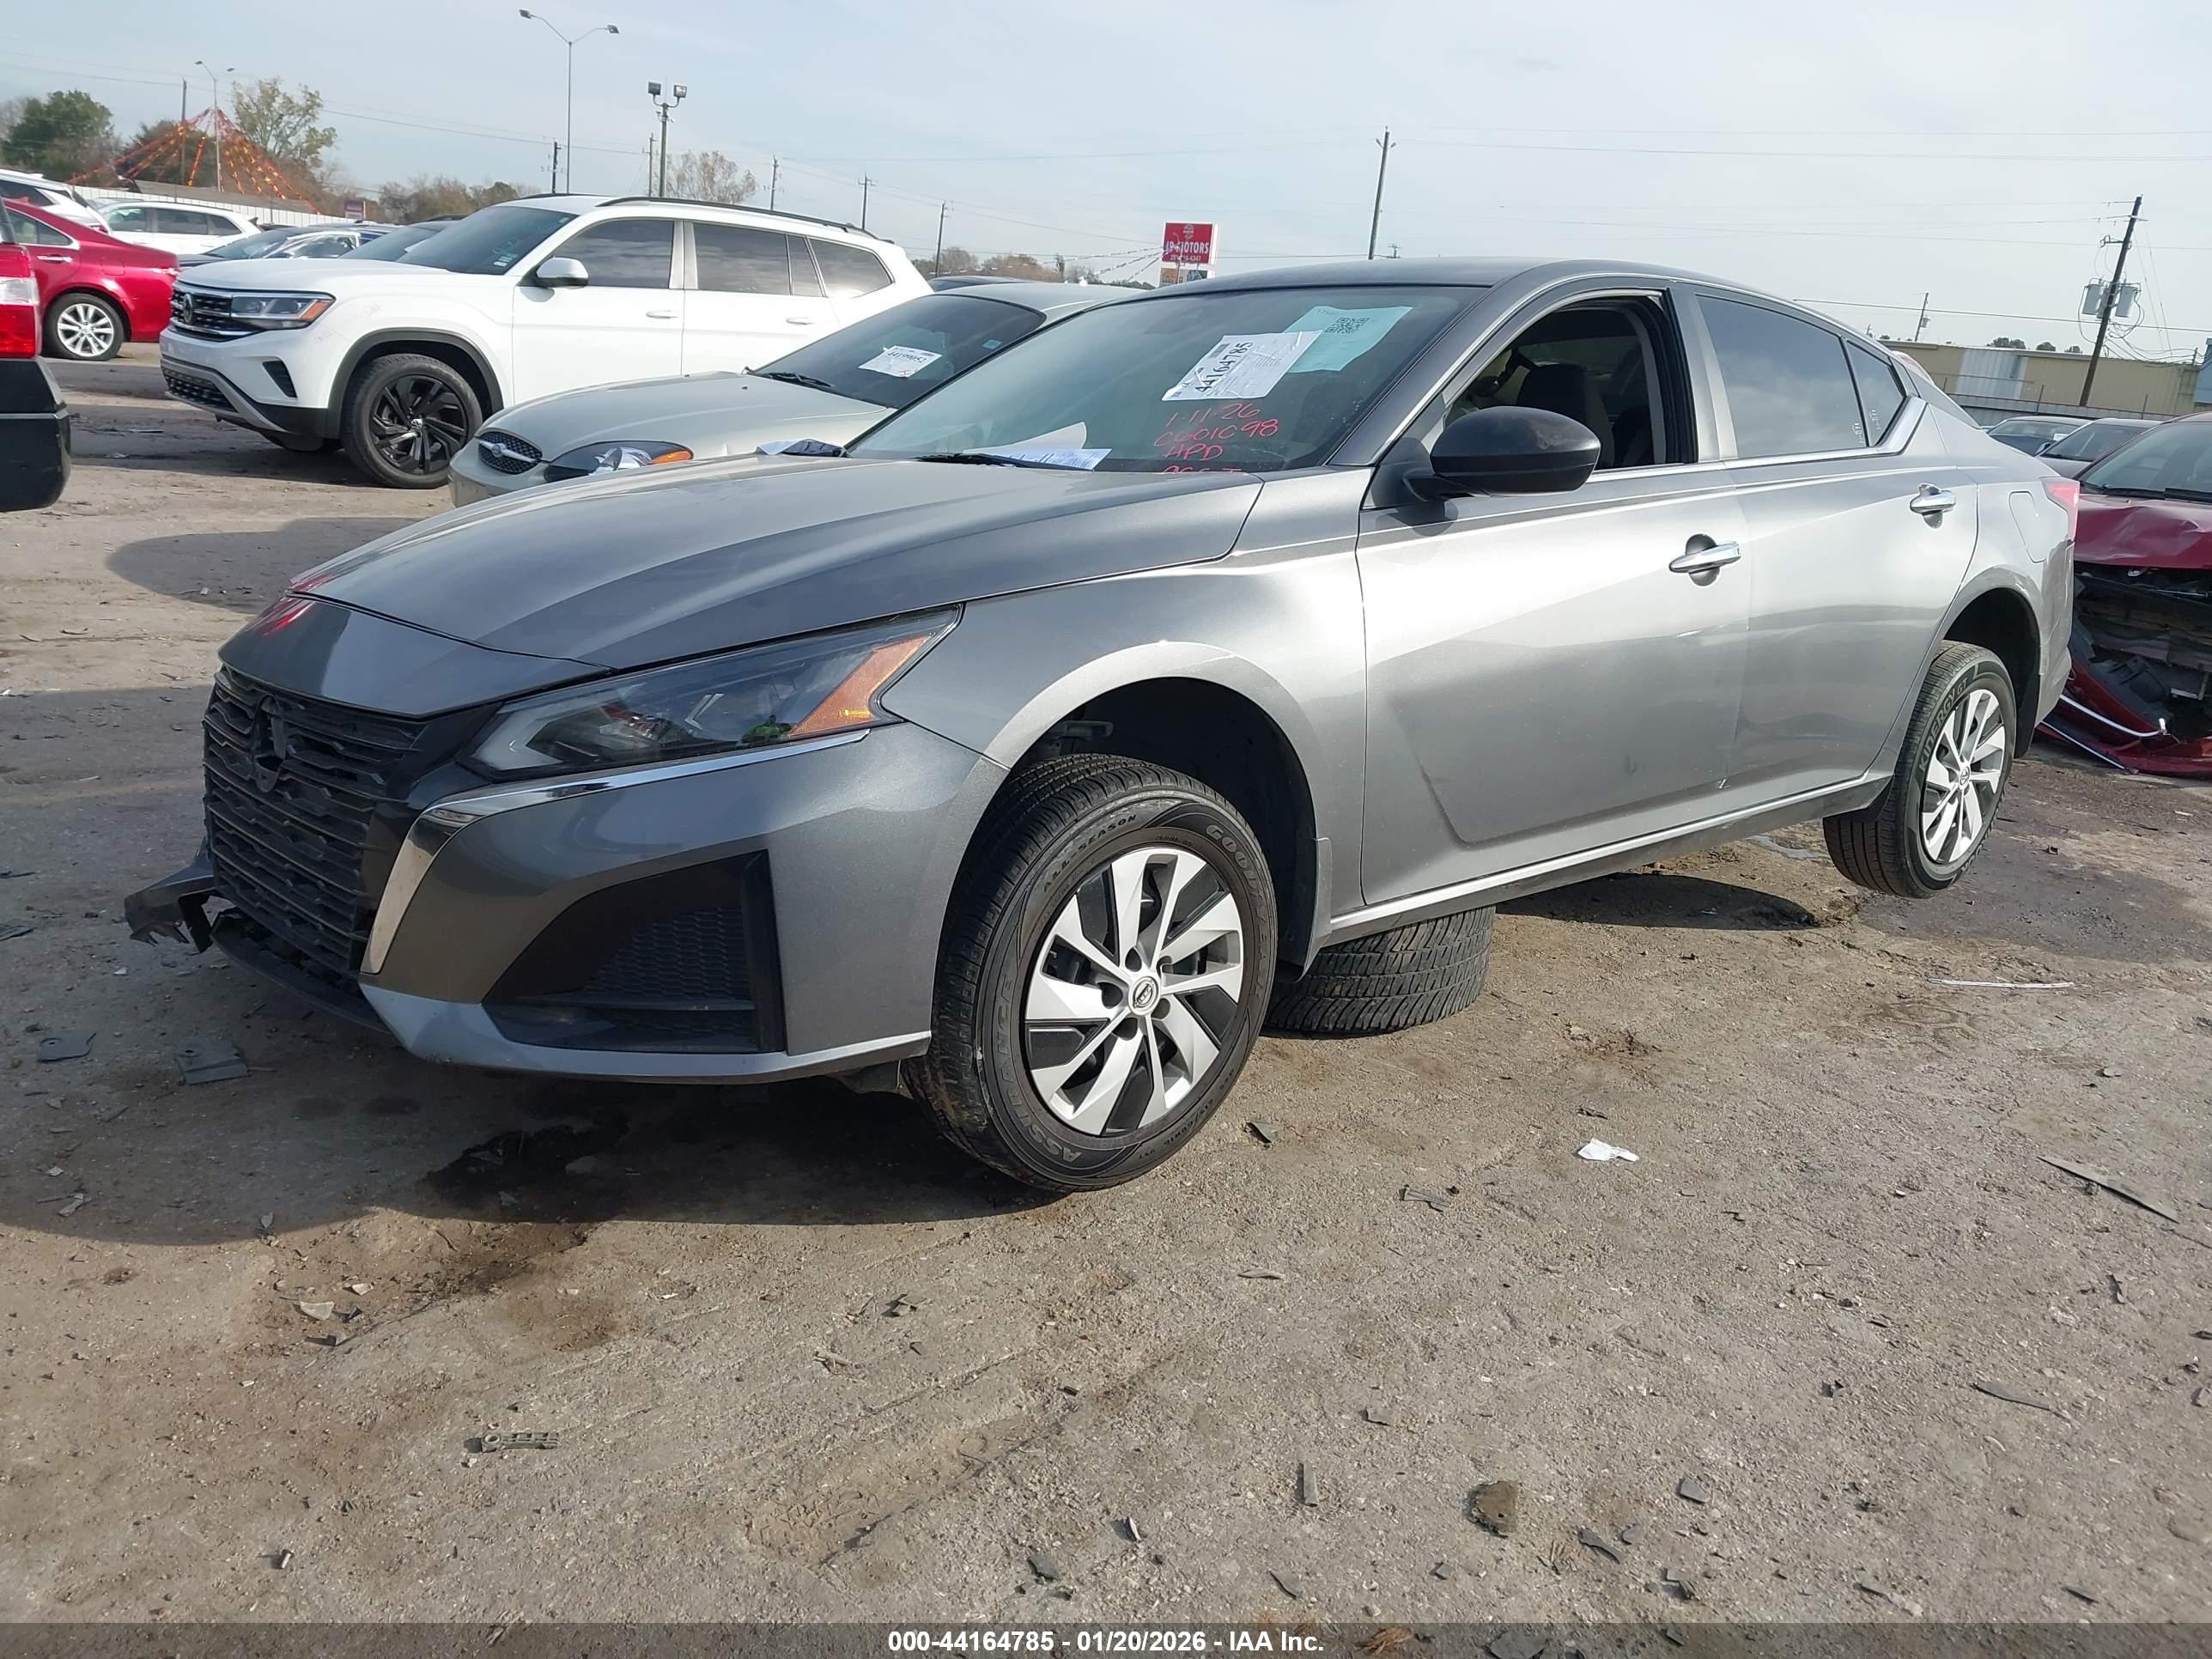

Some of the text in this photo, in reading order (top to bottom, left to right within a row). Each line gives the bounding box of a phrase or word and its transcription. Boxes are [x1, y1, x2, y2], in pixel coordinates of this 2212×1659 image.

[1195, 342, 1253, 392] 44164785
[1206, 824, 1267, 999] GOODYEAR
[997, 975, 1082, 1163] ASSURANCE
